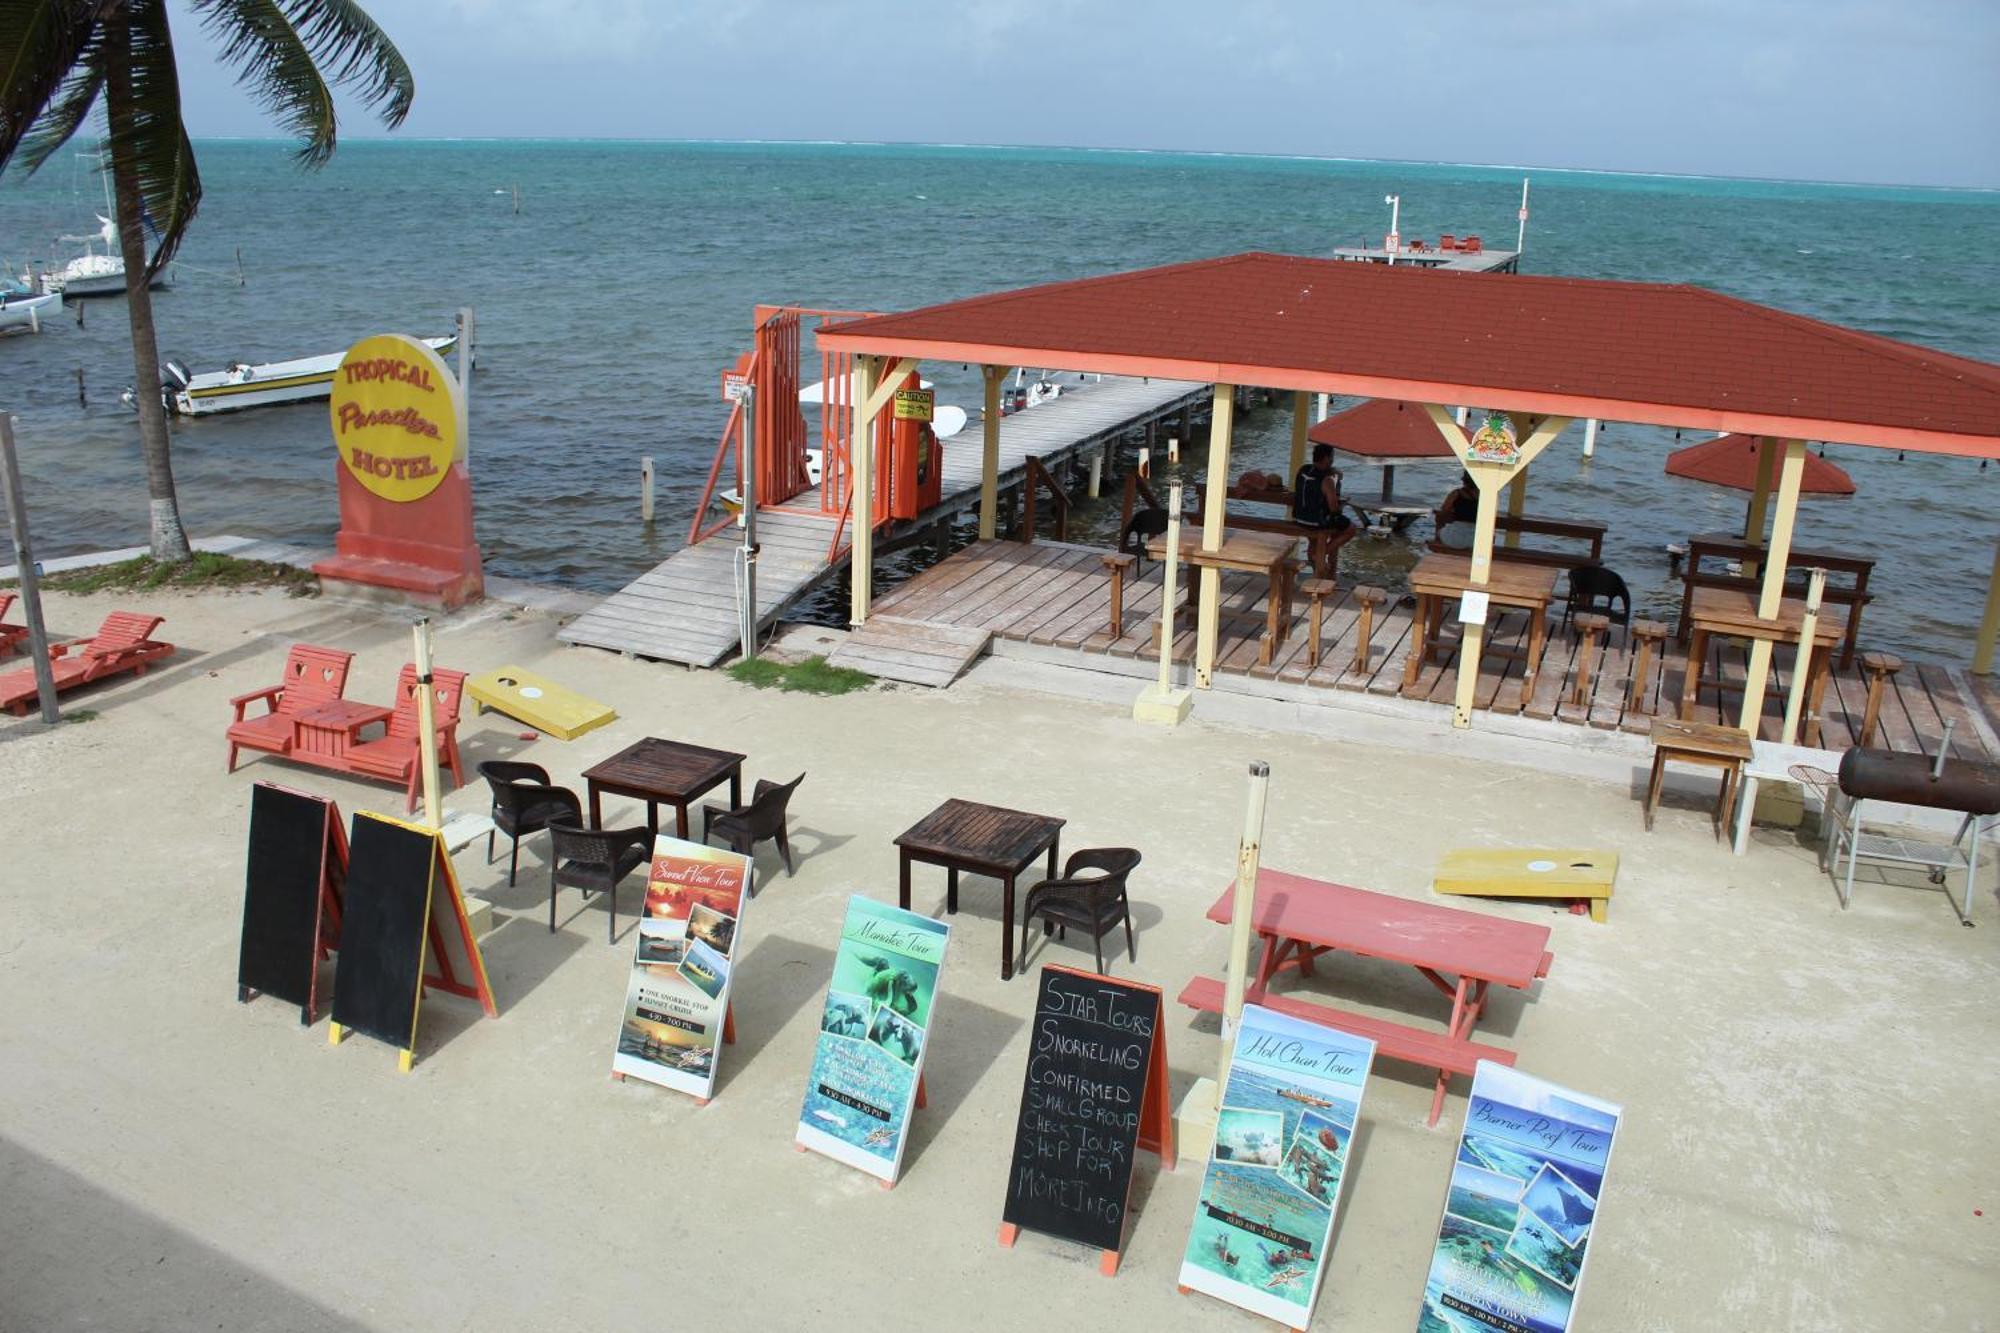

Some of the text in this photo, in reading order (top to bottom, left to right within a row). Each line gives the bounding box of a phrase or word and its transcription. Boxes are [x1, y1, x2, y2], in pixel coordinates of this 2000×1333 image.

[343, 358, 435, 392] TROPICAL
[897, 391, 930, 403] CAUTION
[338, 401, 443, 440] Paradise
[352, 448, 438, 480] HOTEL
[655, 861, 737, 887] Sunset View Tour
[854, 920, 932, 954] Manatee Tour
[660, 990, 690, 1007] SNORKEL
[692, 1001, 709, 1011] STOP
[1045, 977, 1097, 1022] STAR
[1038, 1019, 1142, 1070] SNORKELING
[1279, 1041, 1320, 1068] Chan
[1324, 1051, 1355, 1075] Tour
[1030, 1054, 1131, 1102] CONFIRMED
[1029, 1087, 1137, 1131] SMALL GROUP
[1474, 1102, 1600, 1152] Barrier Reef Tour
[1023, 1110, 1125, 1162] CHECK TOUR
[1023, 1133, 1112, 1181] SHOP FOR
[1017, 1167, 1069, 1207] MORE
